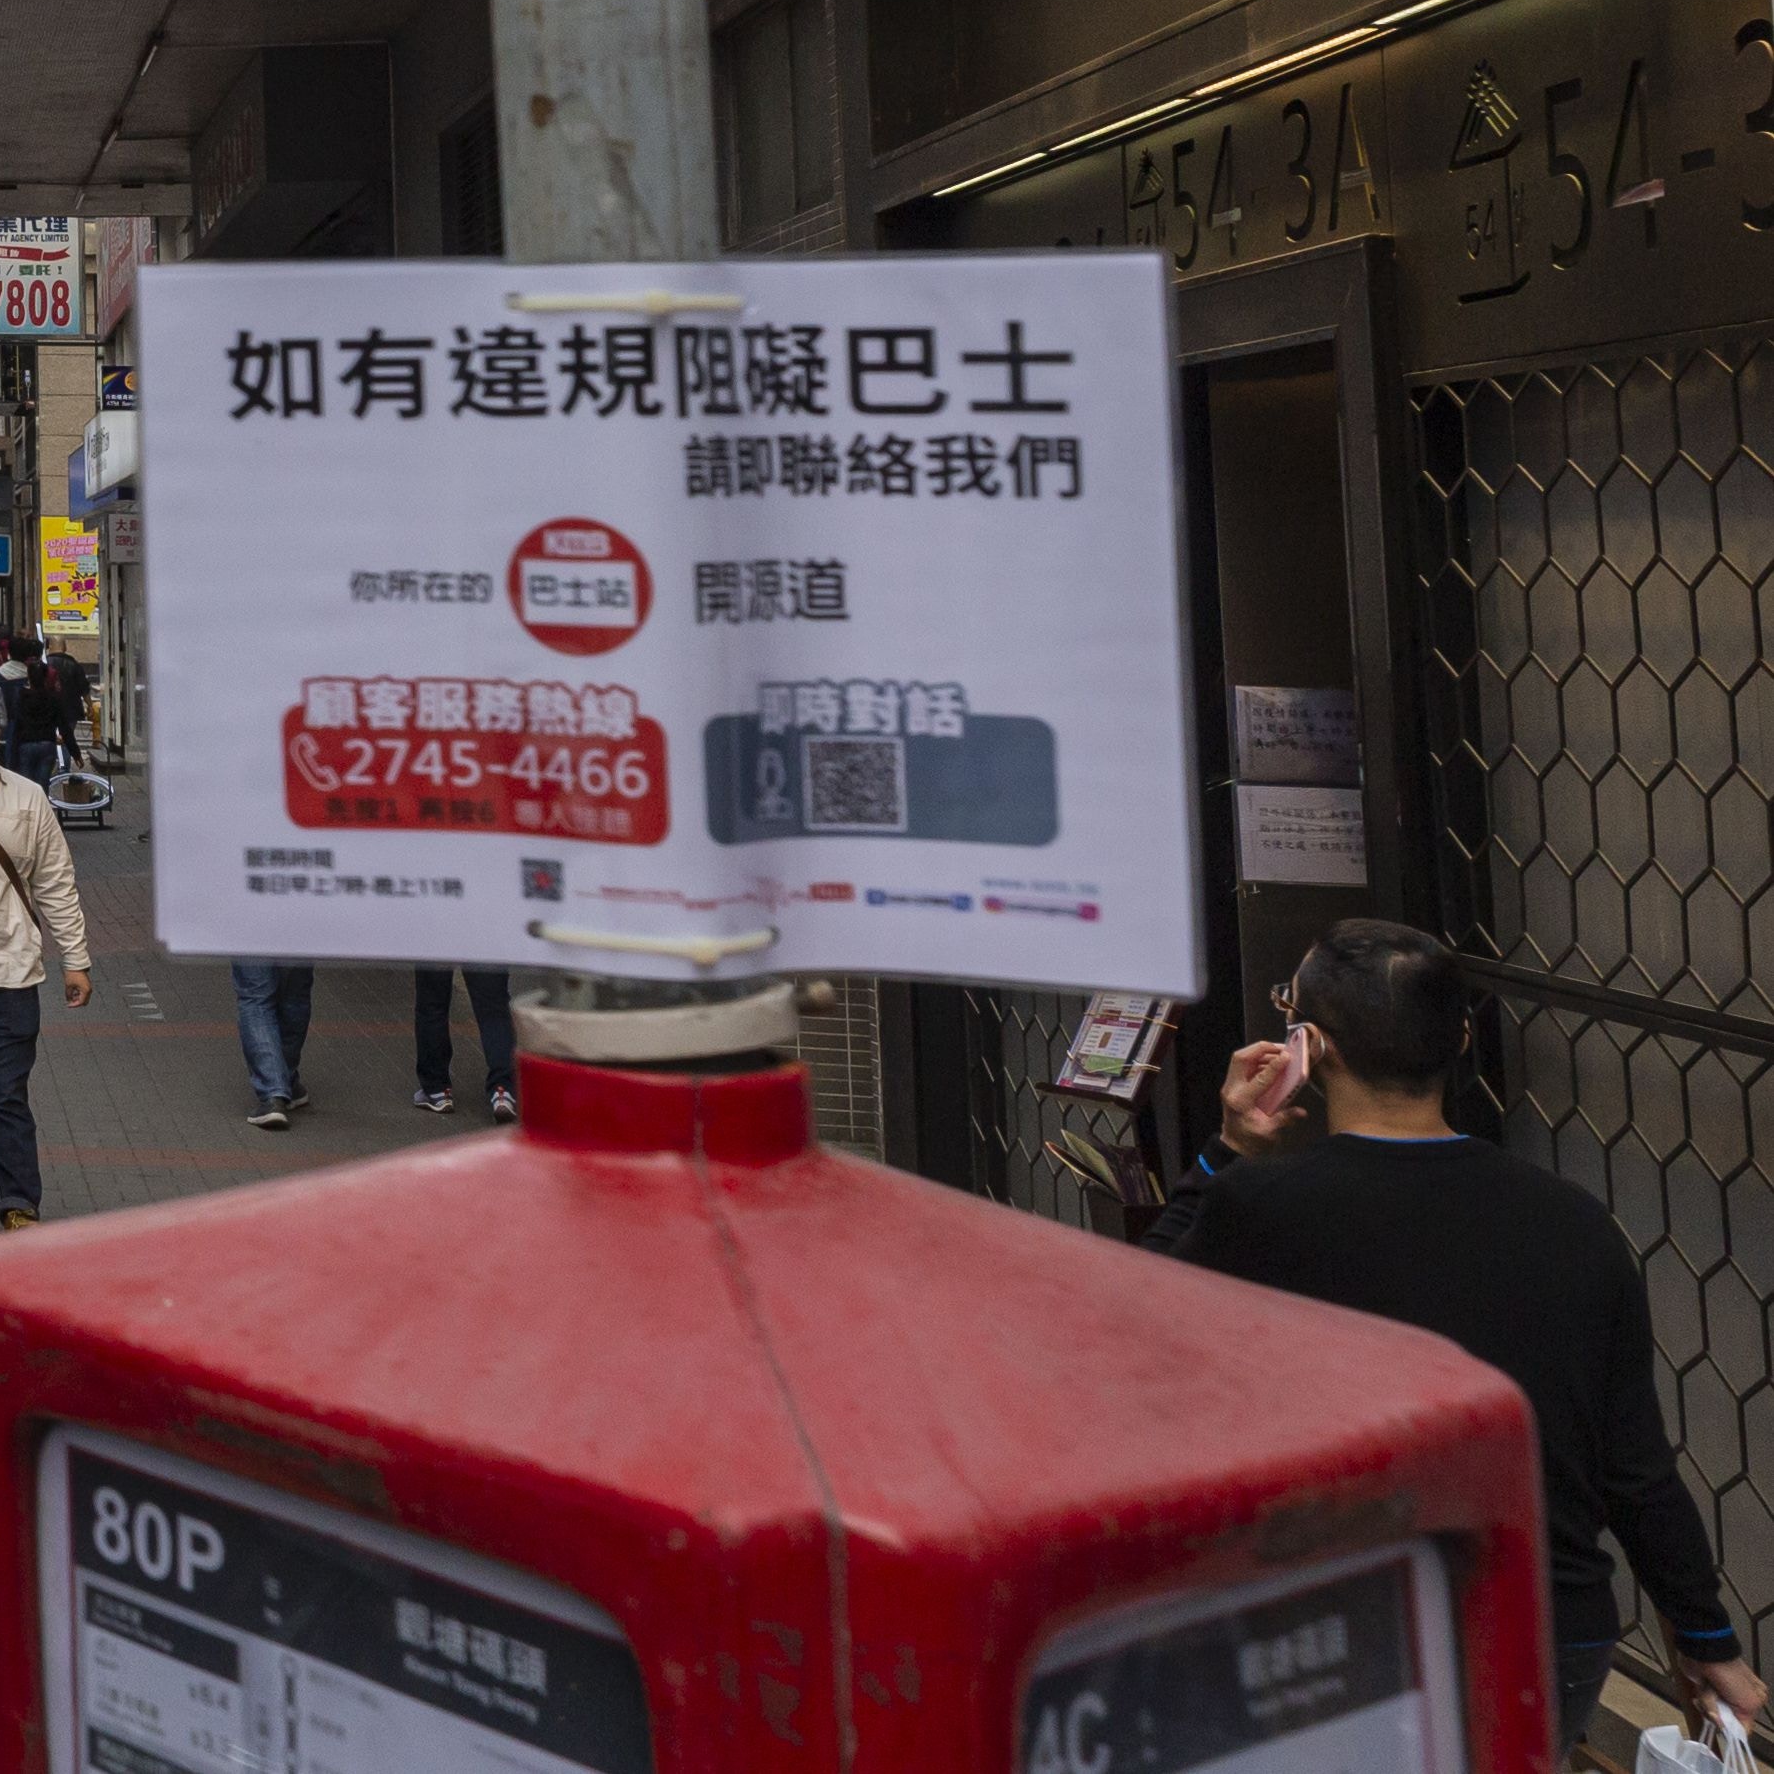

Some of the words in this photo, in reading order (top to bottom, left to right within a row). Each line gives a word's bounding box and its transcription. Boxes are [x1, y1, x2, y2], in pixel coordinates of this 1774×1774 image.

[226, 320, 1074, 420] 如有違規阻礙巴士
[684, 434, 1080, 500] 請即聯絡我們
[351, 570, 495, 606] 你所在的
[693, 558, 850, 624] 開源道
[305, 681, 636, 739] 顧客服務熱線
[342, 739, 650, 799] 2745-4466
[91, 1485, 226, 1593] 80P
